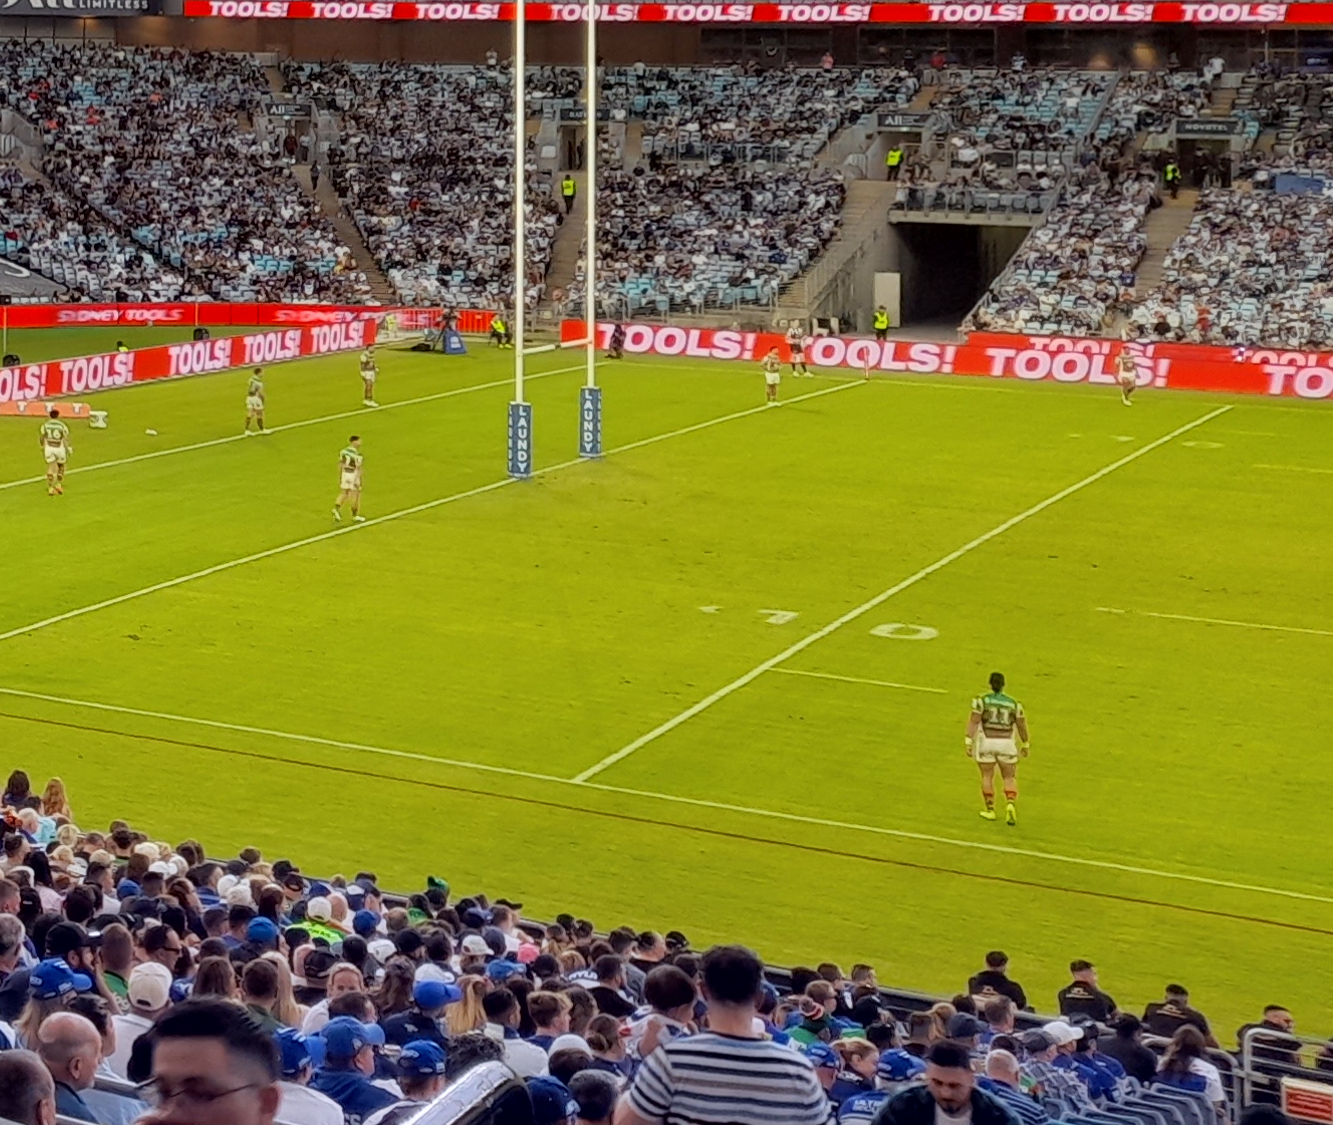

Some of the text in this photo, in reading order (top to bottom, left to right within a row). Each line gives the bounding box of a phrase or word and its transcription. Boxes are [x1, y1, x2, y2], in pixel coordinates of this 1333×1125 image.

[79, 0, 149, 10] LIMITLESS
[208, 0, 1288, 23] TOOLS! TOOLS! TOOLS! TOOLS! TOOLS! TOOLS! TOOLS! TOOLS! TOOLS!
[123, 308, 185, 321] TOOLS
[60, 350, 135, 393] TOOLS!
[168, 338, 232, 376] TOOLS!
[243, 328, 301, 365] TOOLS!
[310, 319, 365, 353] TOOLS!
[596, 322, 758, 361] TOOLS!
[804, 336, 957, 374] OOLS!
[984, 347, 1172, 388] TOOLS!
[517, 405, 528, 473] LAUNDY
[583, 389, 594, 453] LAUNDY
